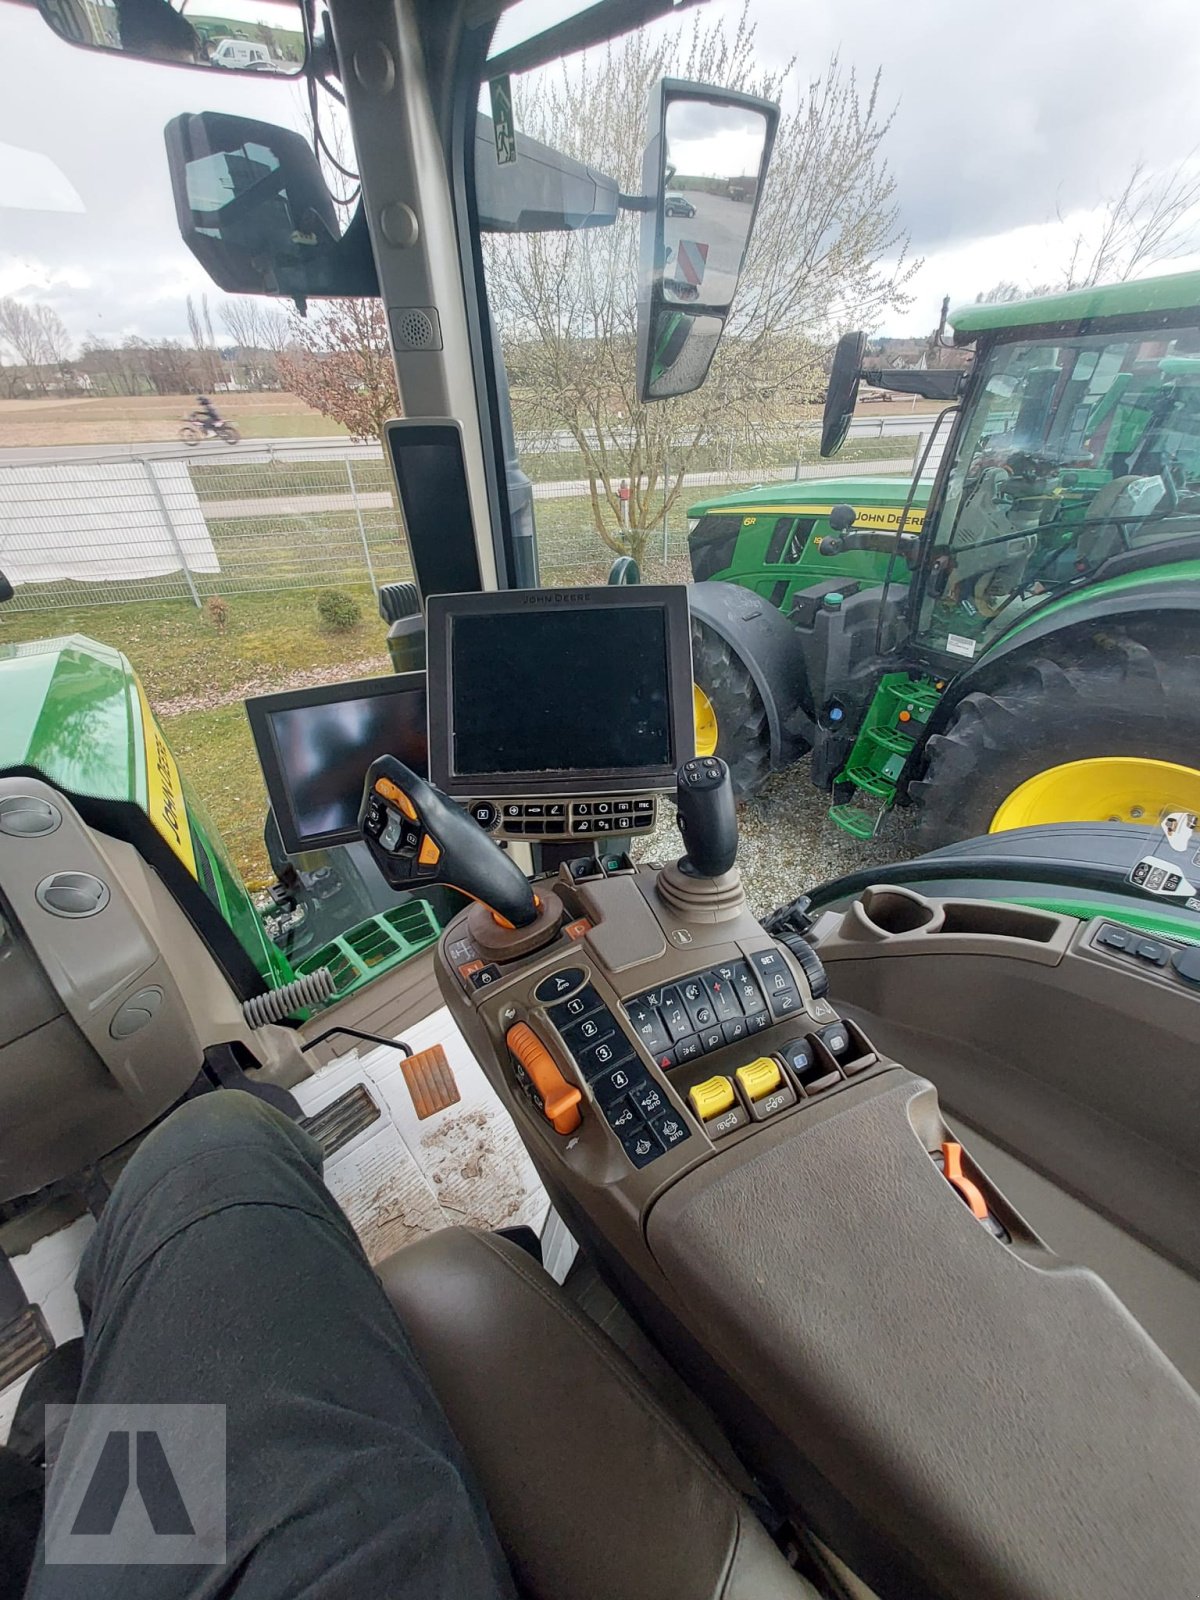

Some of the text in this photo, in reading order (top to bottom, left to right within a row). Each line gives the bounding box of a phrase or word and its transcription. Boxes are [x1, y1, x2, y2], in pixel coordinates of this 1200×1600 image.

[743, 517, 757, 526] 6R
[855, 512, 885, 522] JOHN
[523, 593, 592, 604] JOHN DEERE
[161, 779, 181, 845] JOHN
[760, 955, 775, 965] SET
[558, 982, 570, 991] AUTO
[585, 1024, 595, 1034] 2
[599, 1048, 608, 1058] 3
[616, 1074, 625, 1085] 4
[647, 1099, 661, 1111] AUTO
[670, 1130, 684, 1142] AUTO
